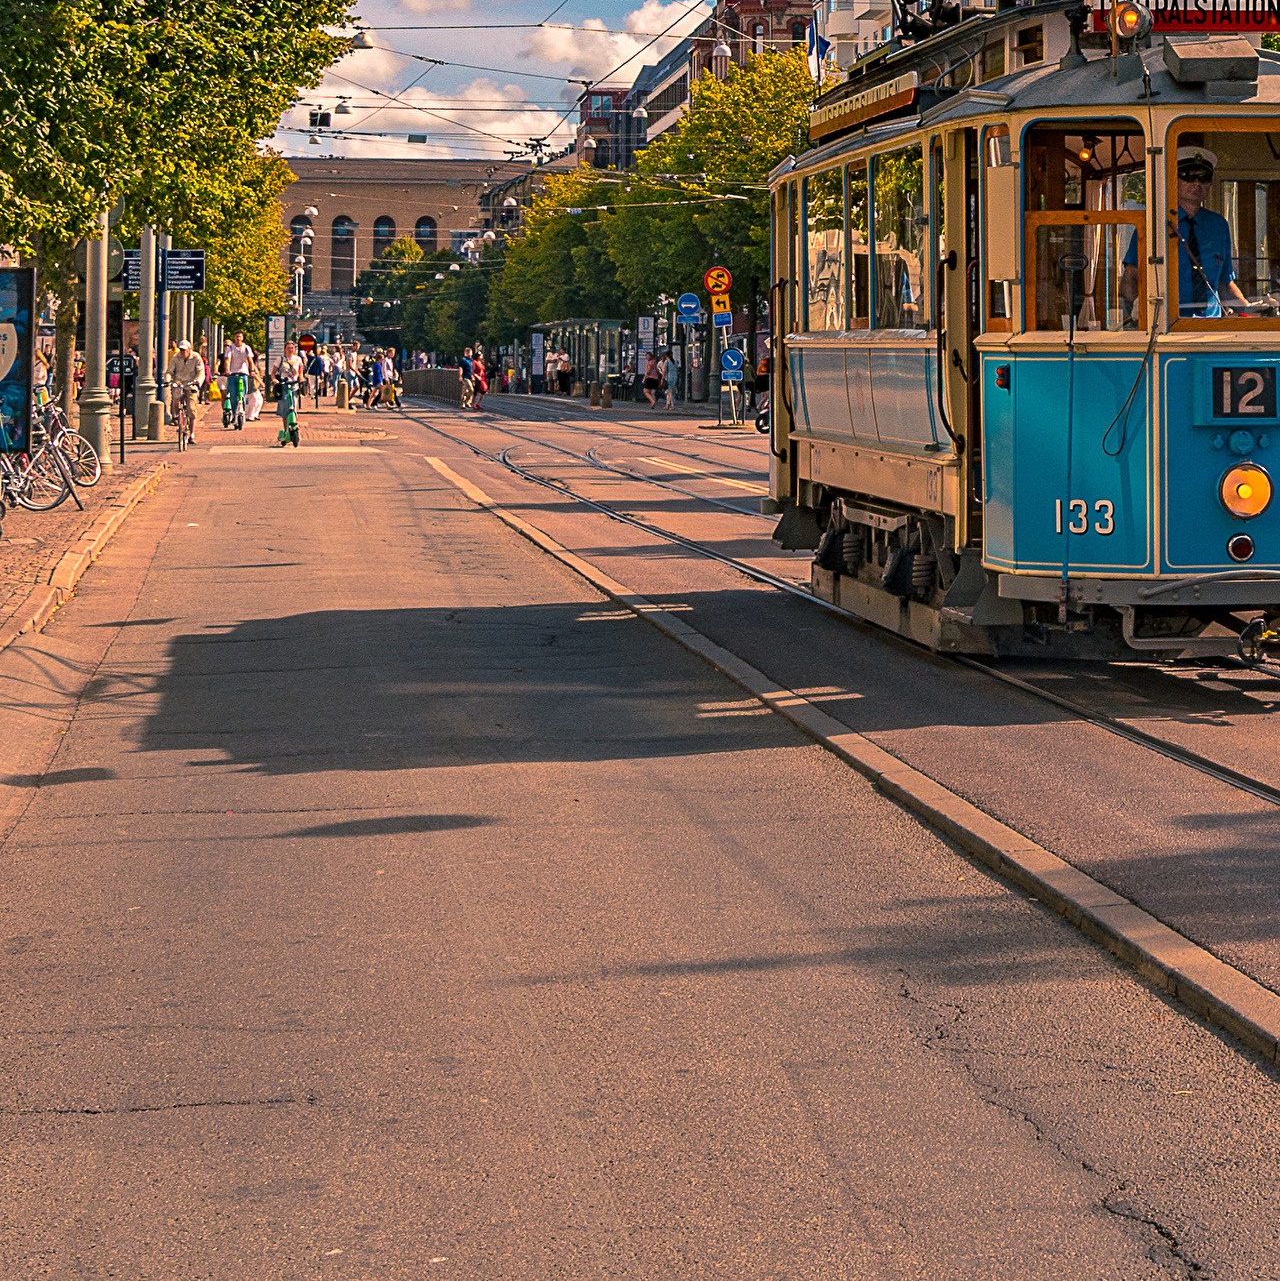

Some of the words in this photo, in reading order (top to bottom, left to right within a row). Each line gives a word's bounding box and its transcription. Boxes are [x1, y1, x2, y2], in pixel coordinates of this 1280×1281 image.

[274, 318, 280, 330] C
[1222, 371, 1265, 414] 12
[1055, 499, 1116, 535] 133
